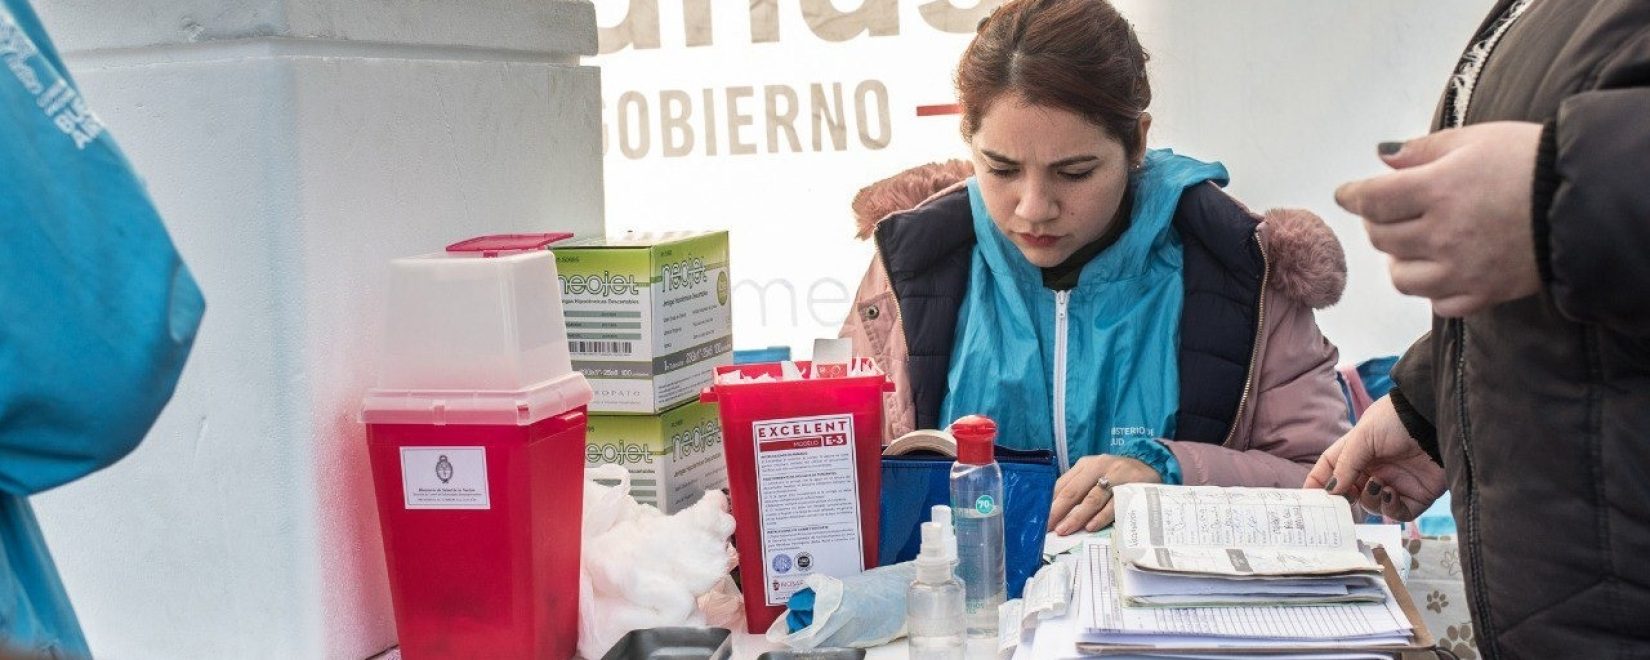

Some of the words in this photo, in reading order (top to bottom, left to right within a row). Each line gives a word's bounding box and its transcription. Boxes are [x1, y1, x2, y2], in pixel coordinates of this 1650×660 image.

[602, 79, 892, 161] OBIERNO
[662, 254, 708, 293] neojet
[758, 421, 847, 438] EXCELENT
[587, 438, 654, 466] eojet
[793, 440, 820, 448] MODELO
[1110, 437, 1125, 447] UD
